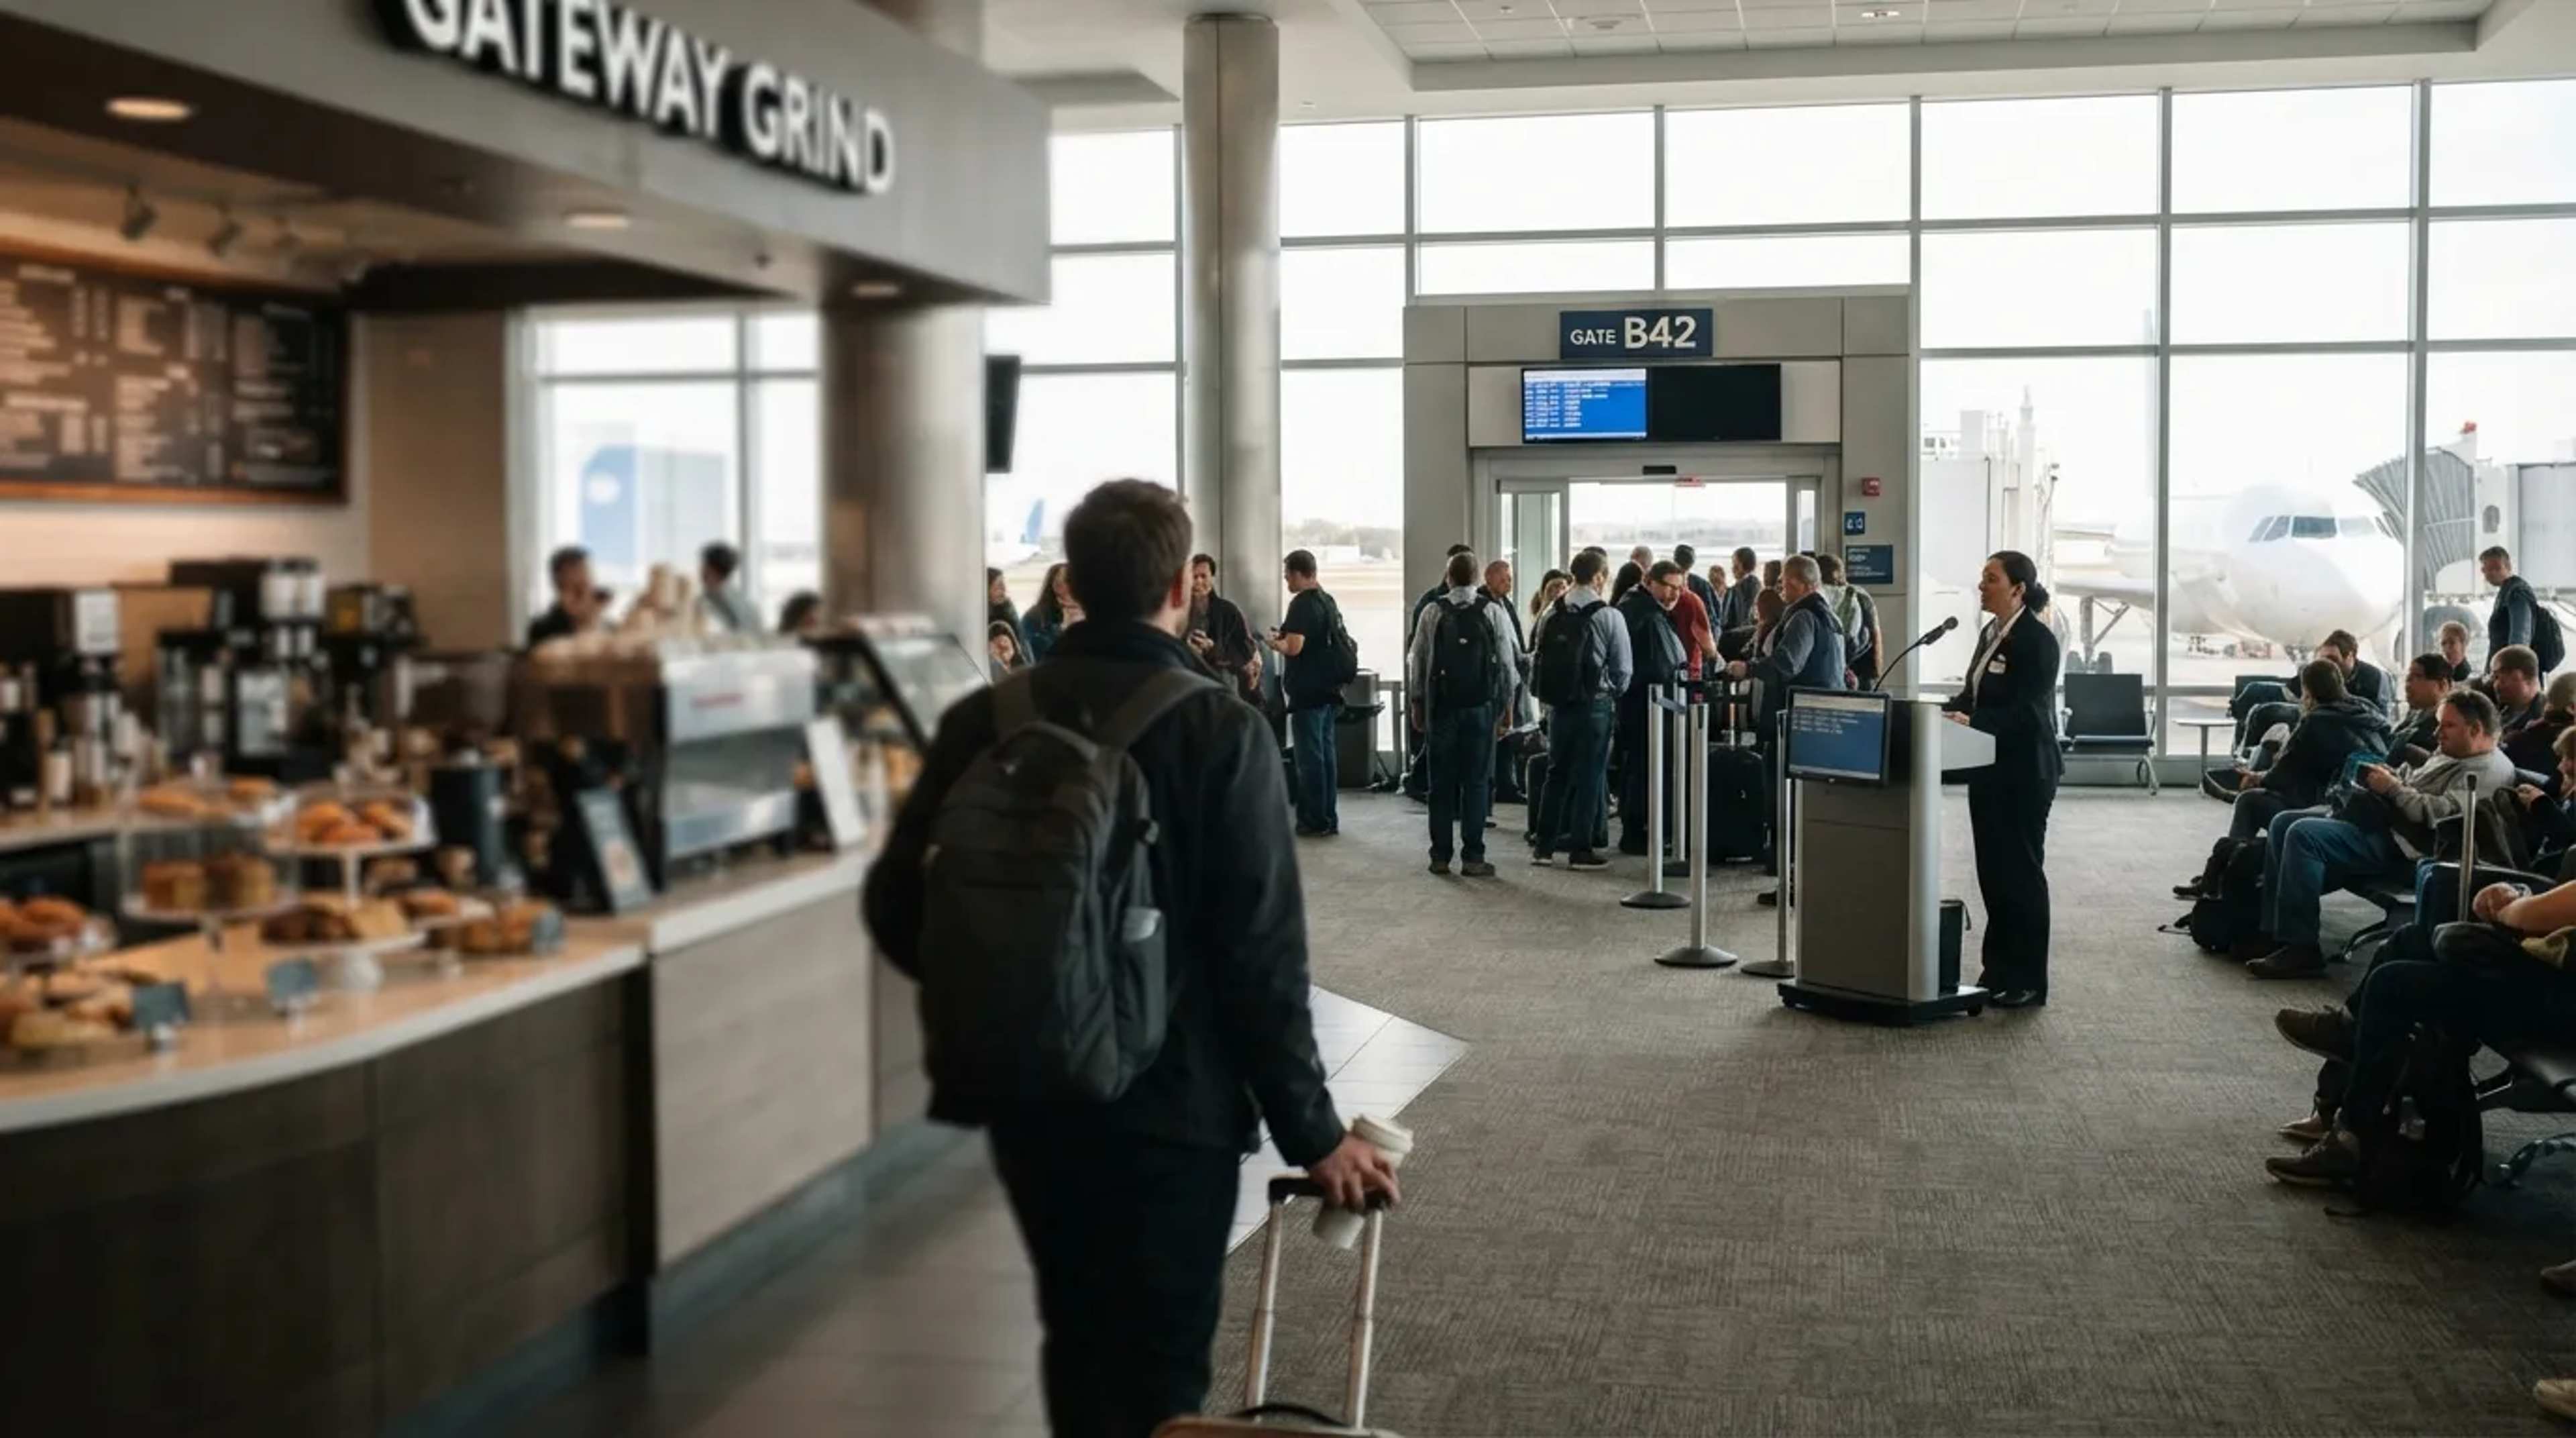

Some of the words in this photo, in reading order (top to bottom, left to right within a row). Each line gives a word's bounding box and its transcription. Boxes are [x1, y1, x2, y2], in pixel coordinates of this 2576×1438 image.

[743, 62, 896, 194] GRIND
[1570, 329, 1617, 346] GATE
[1624, 315, 1697, 349] B42
